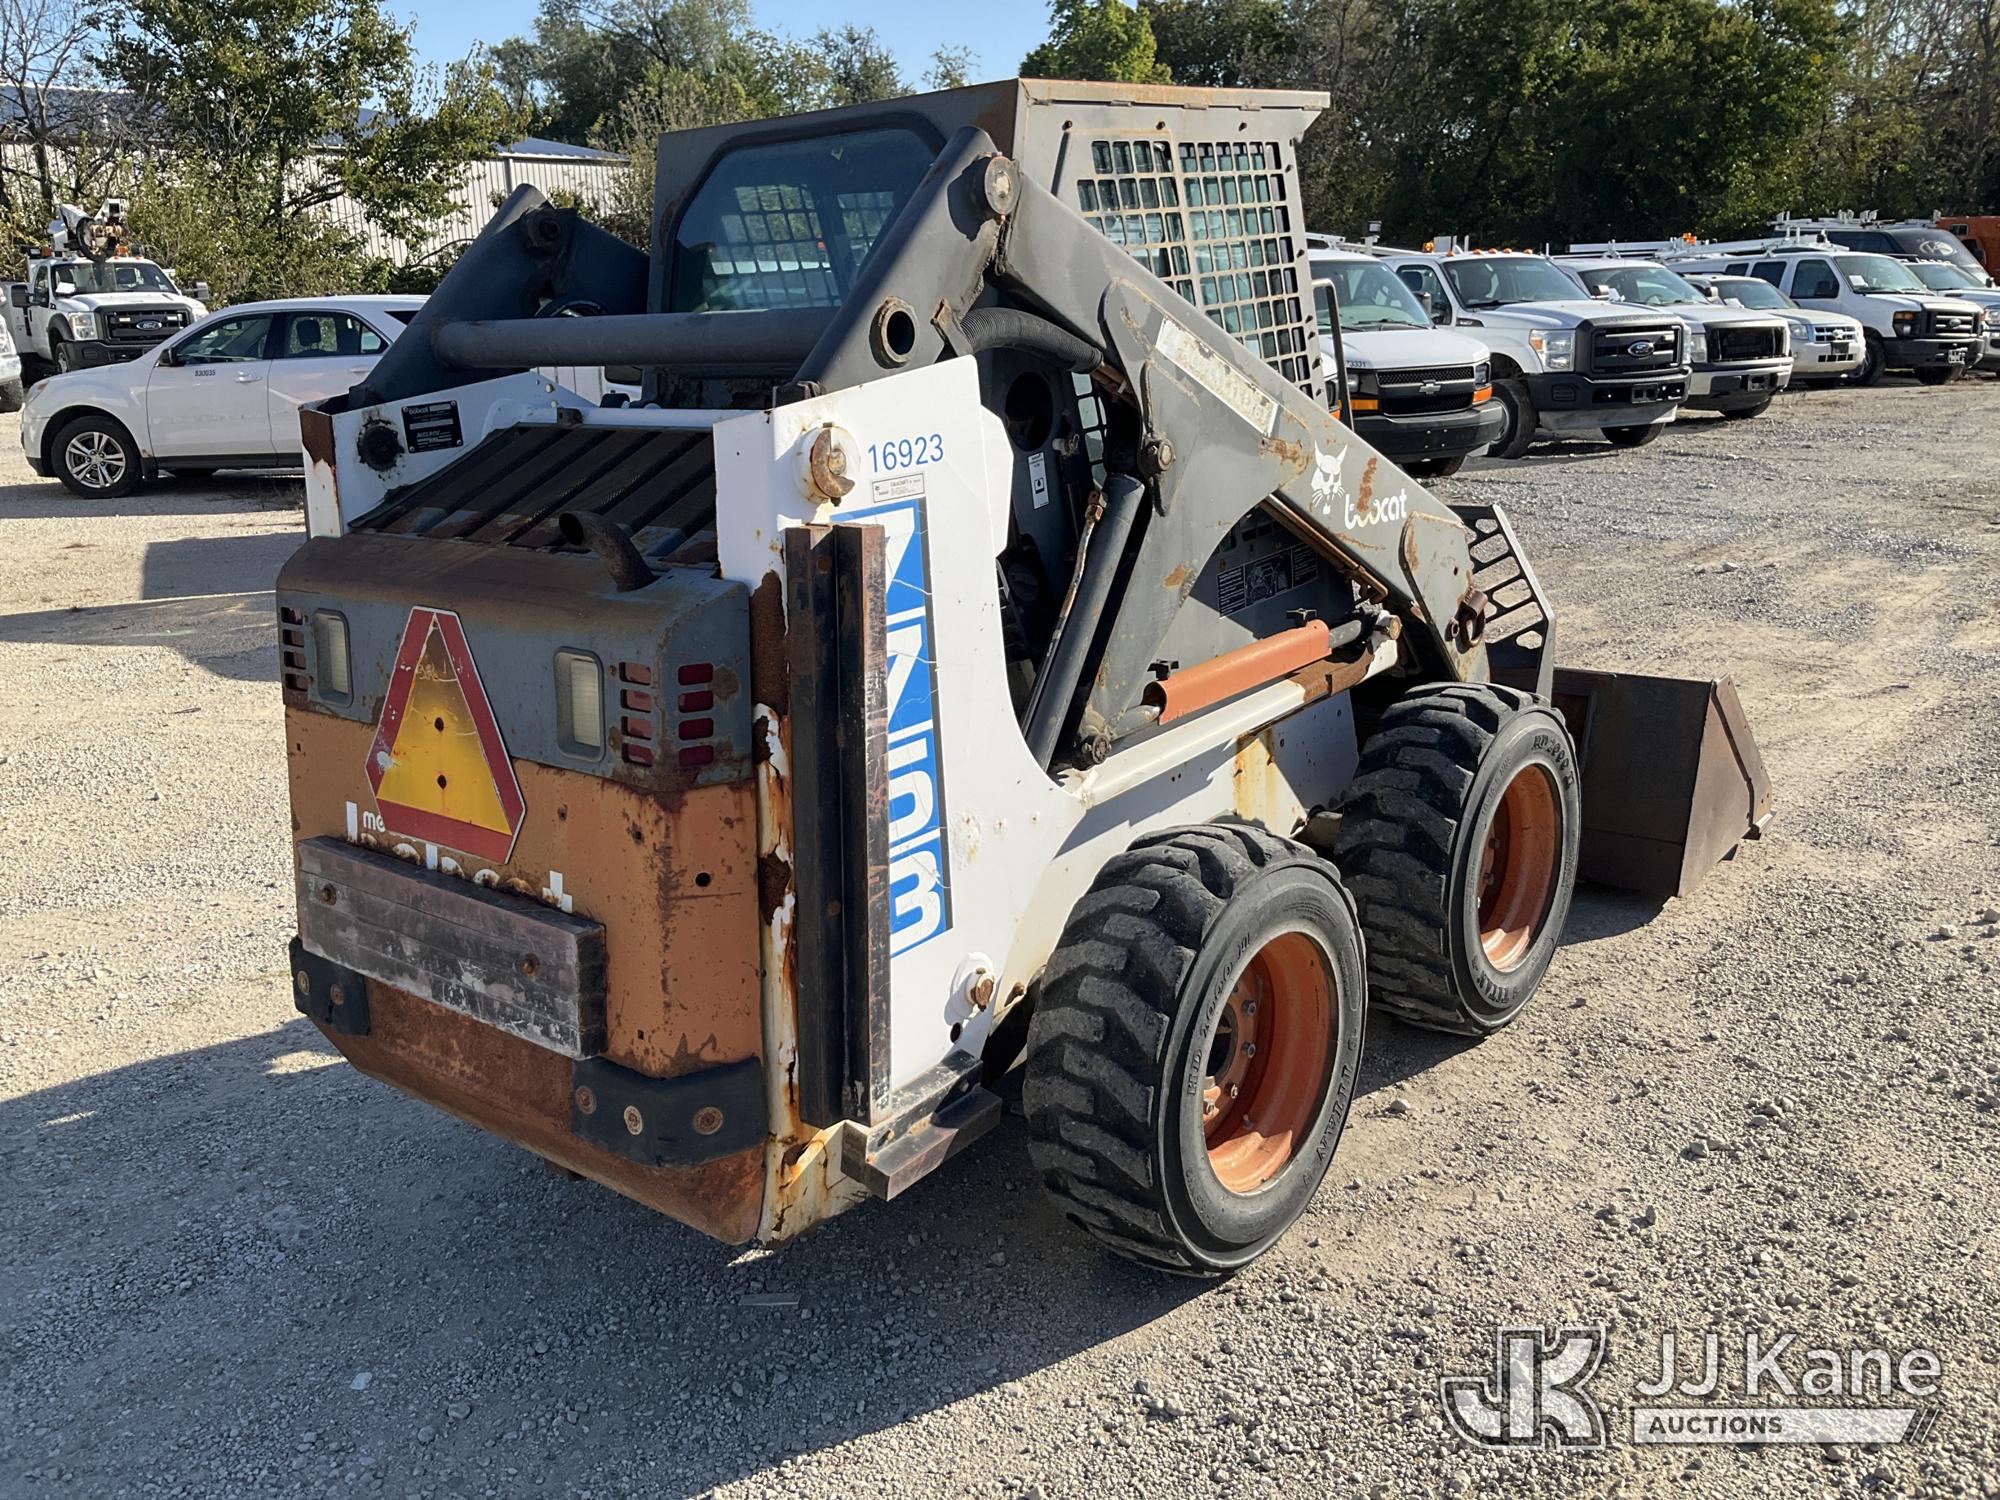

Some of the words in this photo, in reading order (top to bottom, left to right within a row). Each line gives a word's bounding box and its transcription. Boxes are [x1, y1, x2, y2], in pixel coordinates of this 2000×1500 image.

[868, 433, 944, 473] 16923
[1187, 1049, 1203, 1096] HD
[1201, 961, 1234, 1038] 2000
